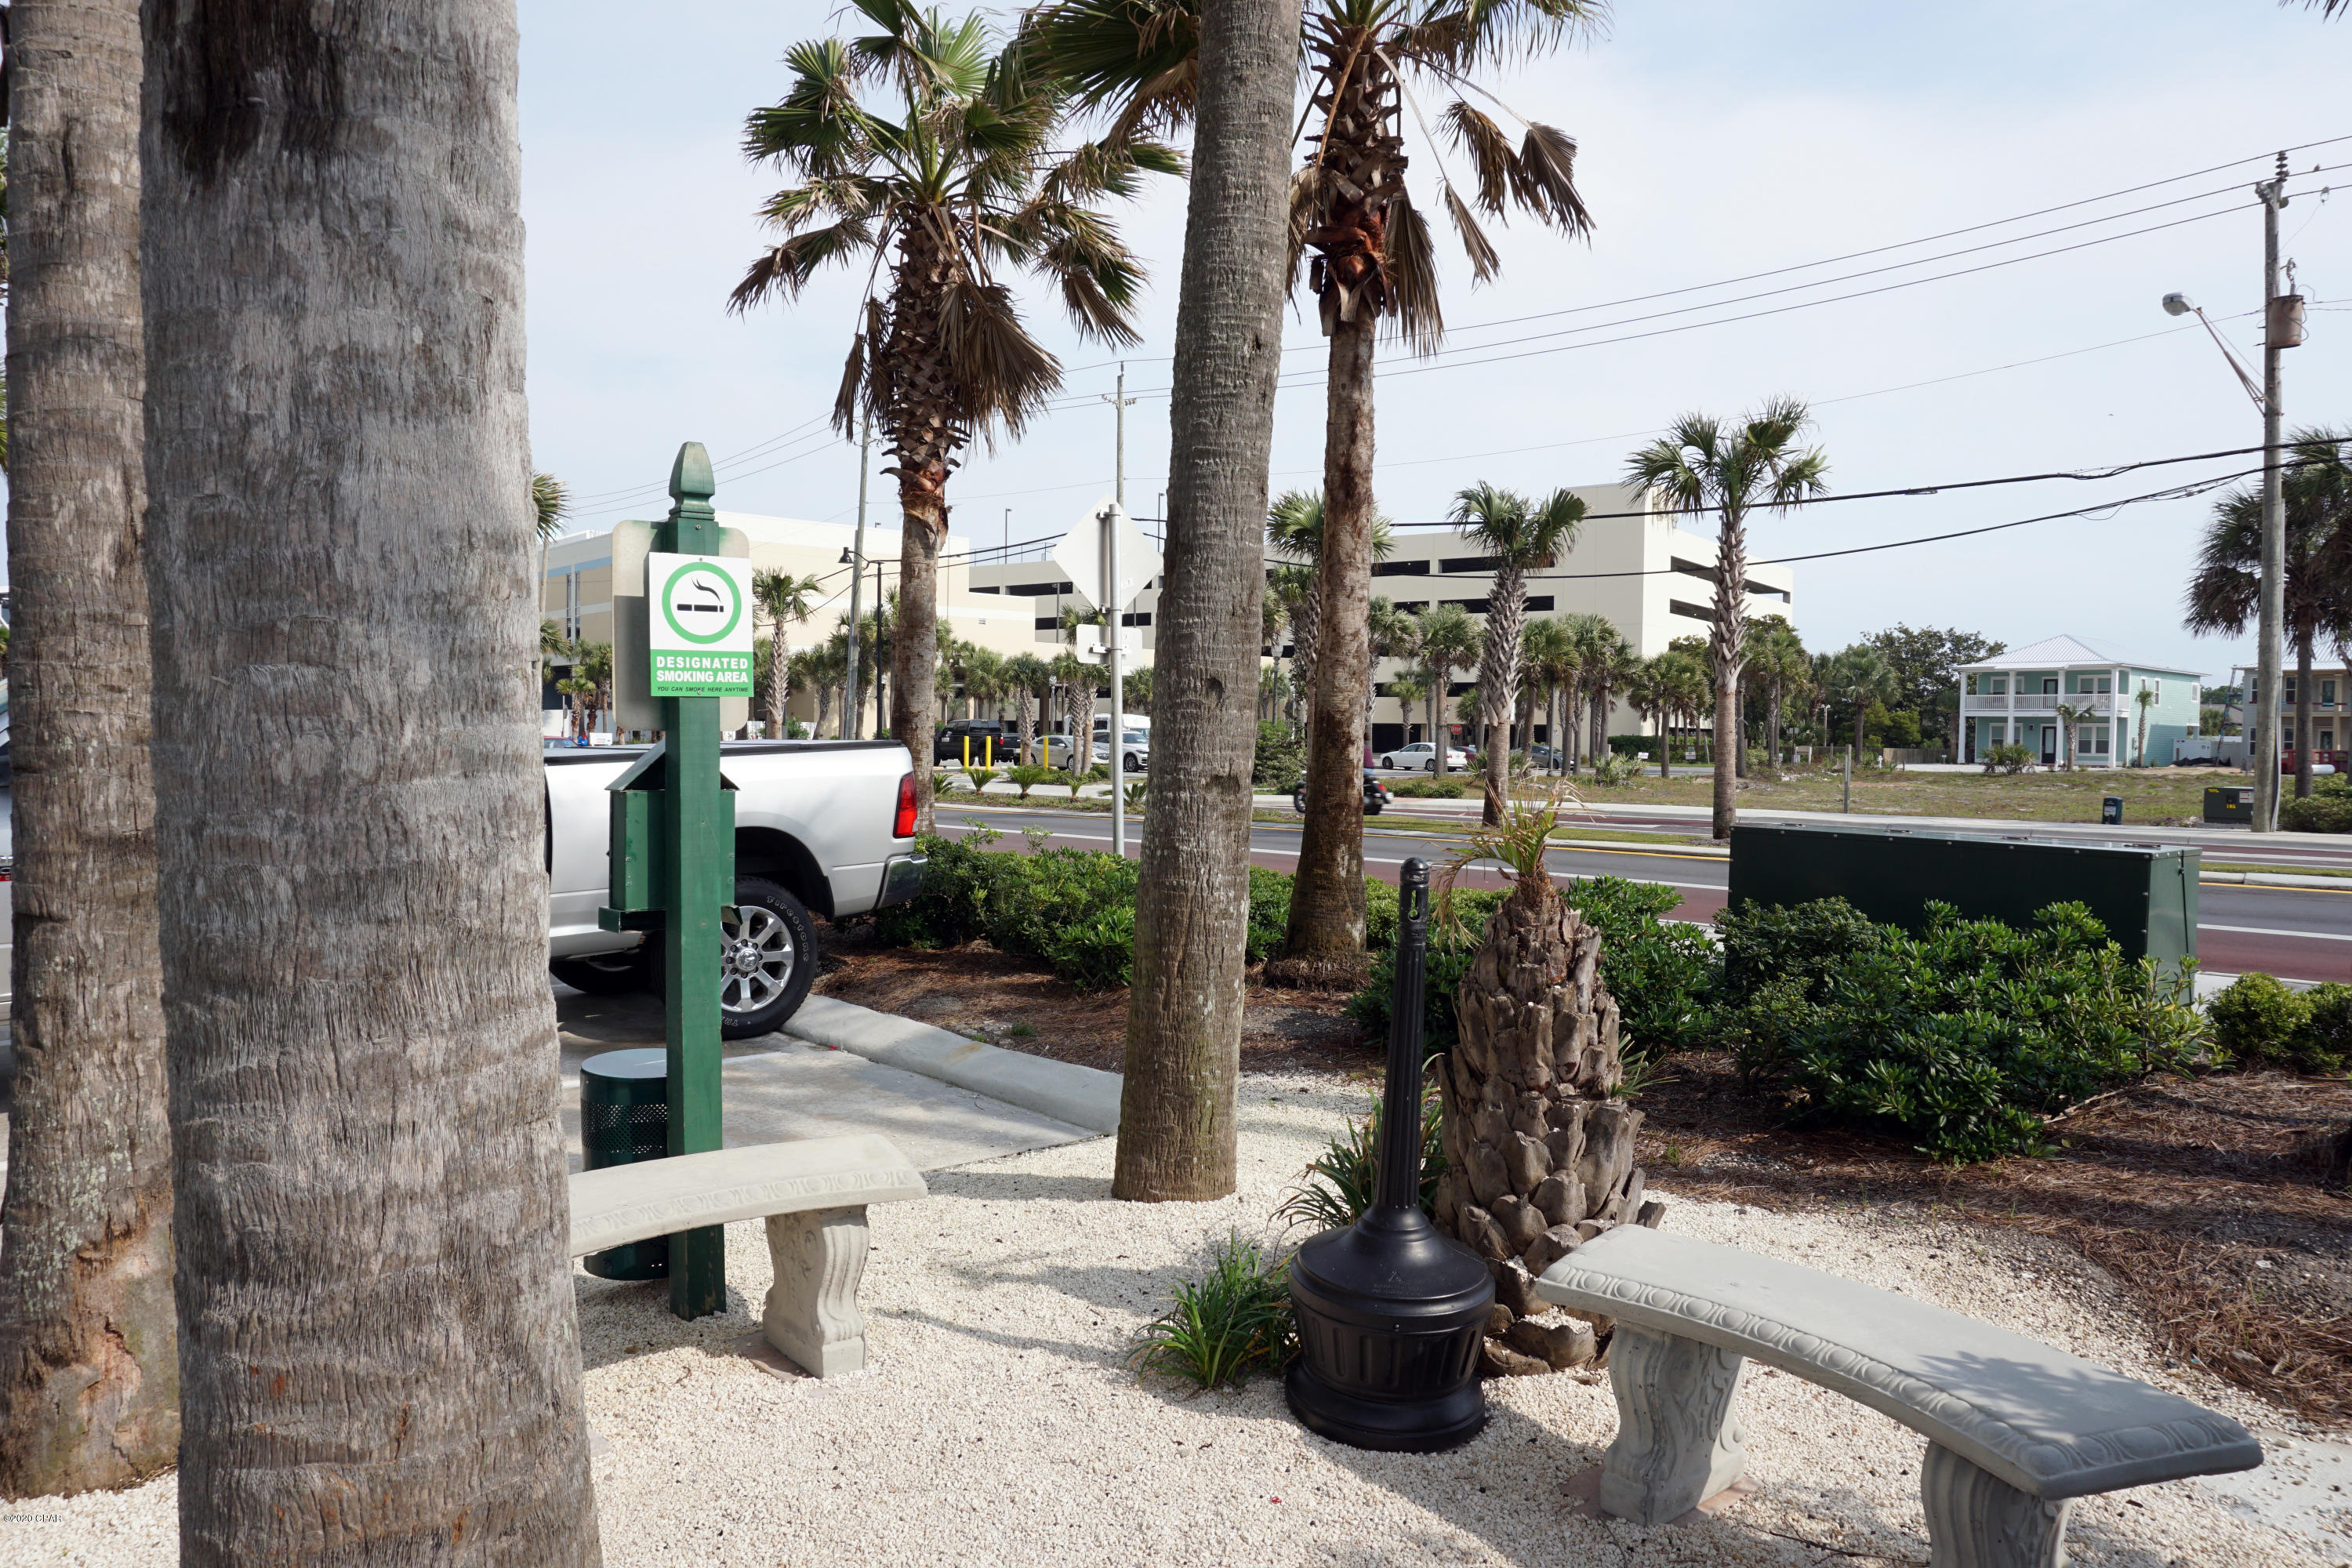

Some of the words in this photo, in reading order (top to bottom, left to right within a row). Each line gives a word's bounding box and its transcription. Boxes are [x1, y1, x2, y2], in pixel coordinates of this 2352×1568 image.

[656, 656, 748, 669] DESIGNATED
[656, 670, 714, 682] SMOKING
[716, 671, 749, 683] AREA
